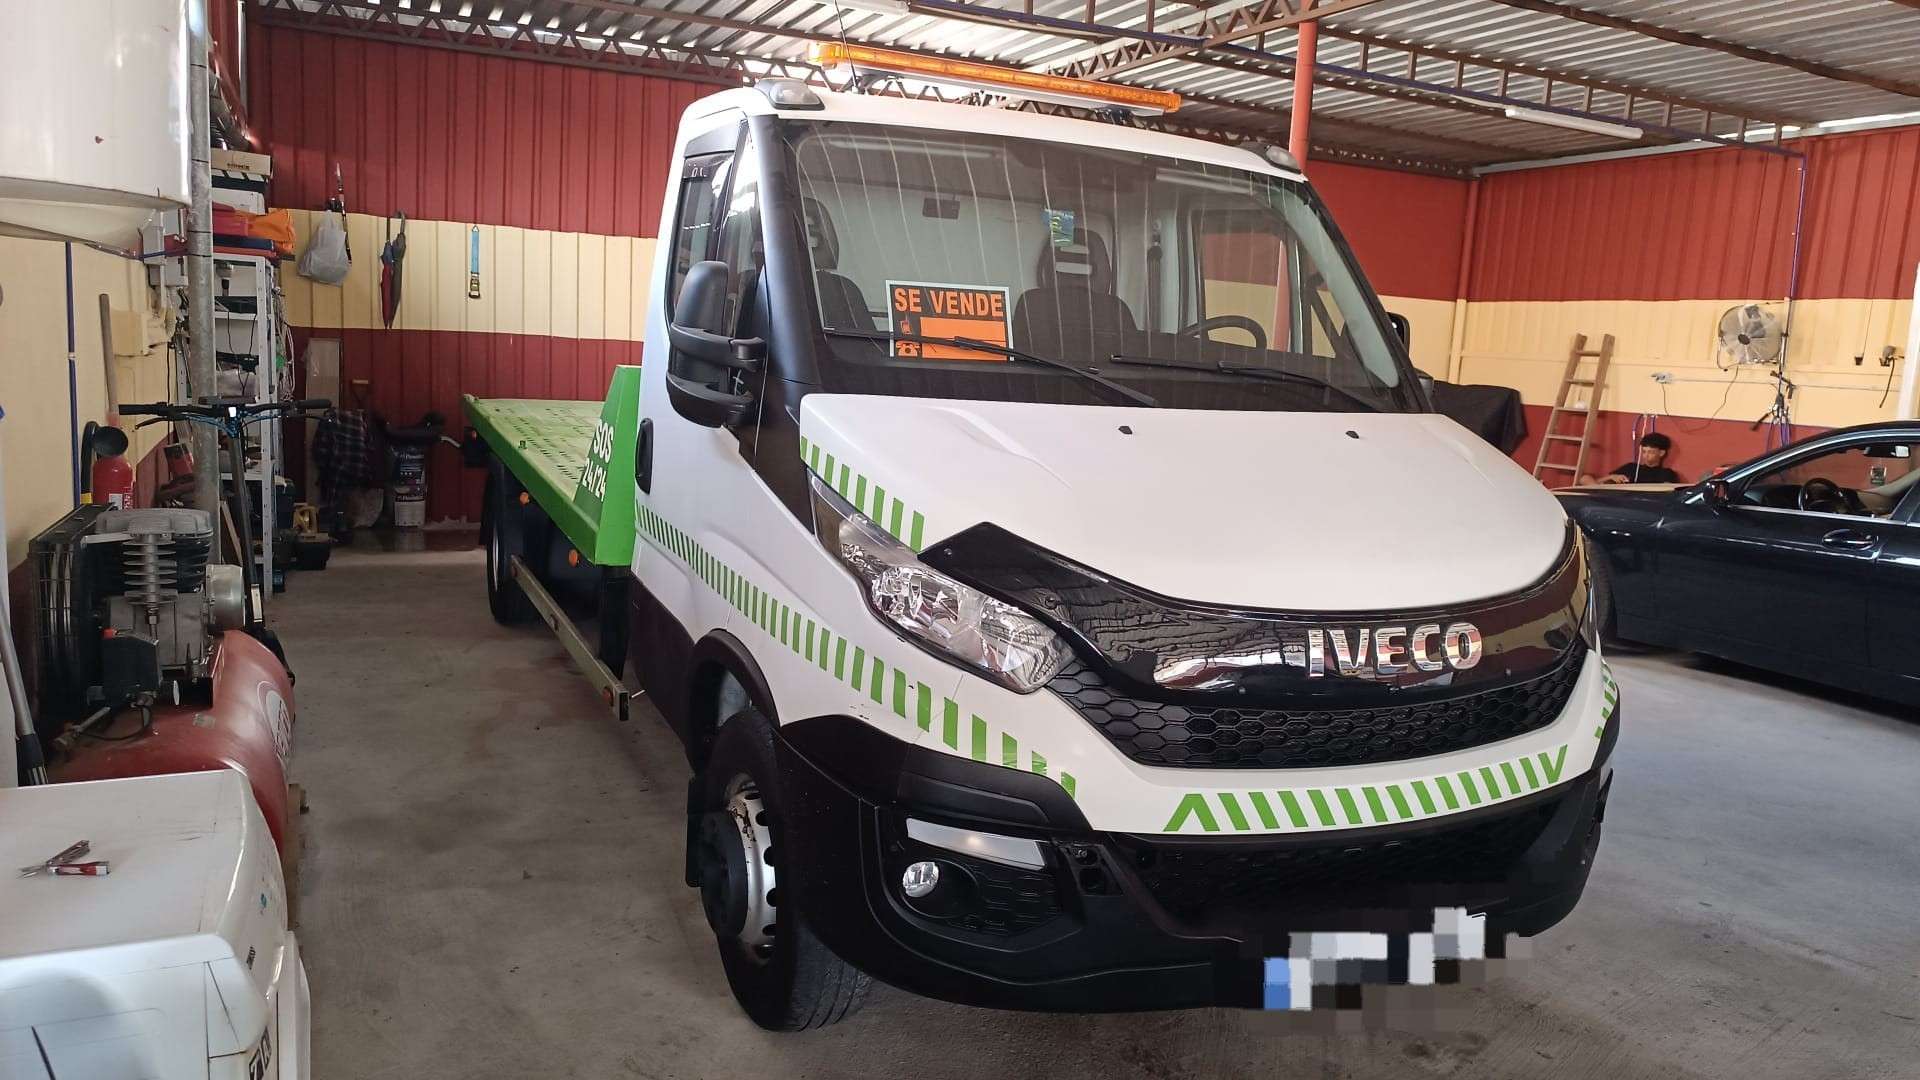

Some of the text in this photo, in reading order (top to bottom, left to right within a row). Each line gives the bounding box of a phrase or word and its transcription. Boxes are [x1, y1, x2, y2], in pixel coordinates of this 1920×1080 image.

[894, 287, 1004, 318] SE VENDE
[593, 418, 614, 464] SOS
[582, 457, 607, 502] 24/24
[1307, 622, 1482, 678] IVECO
